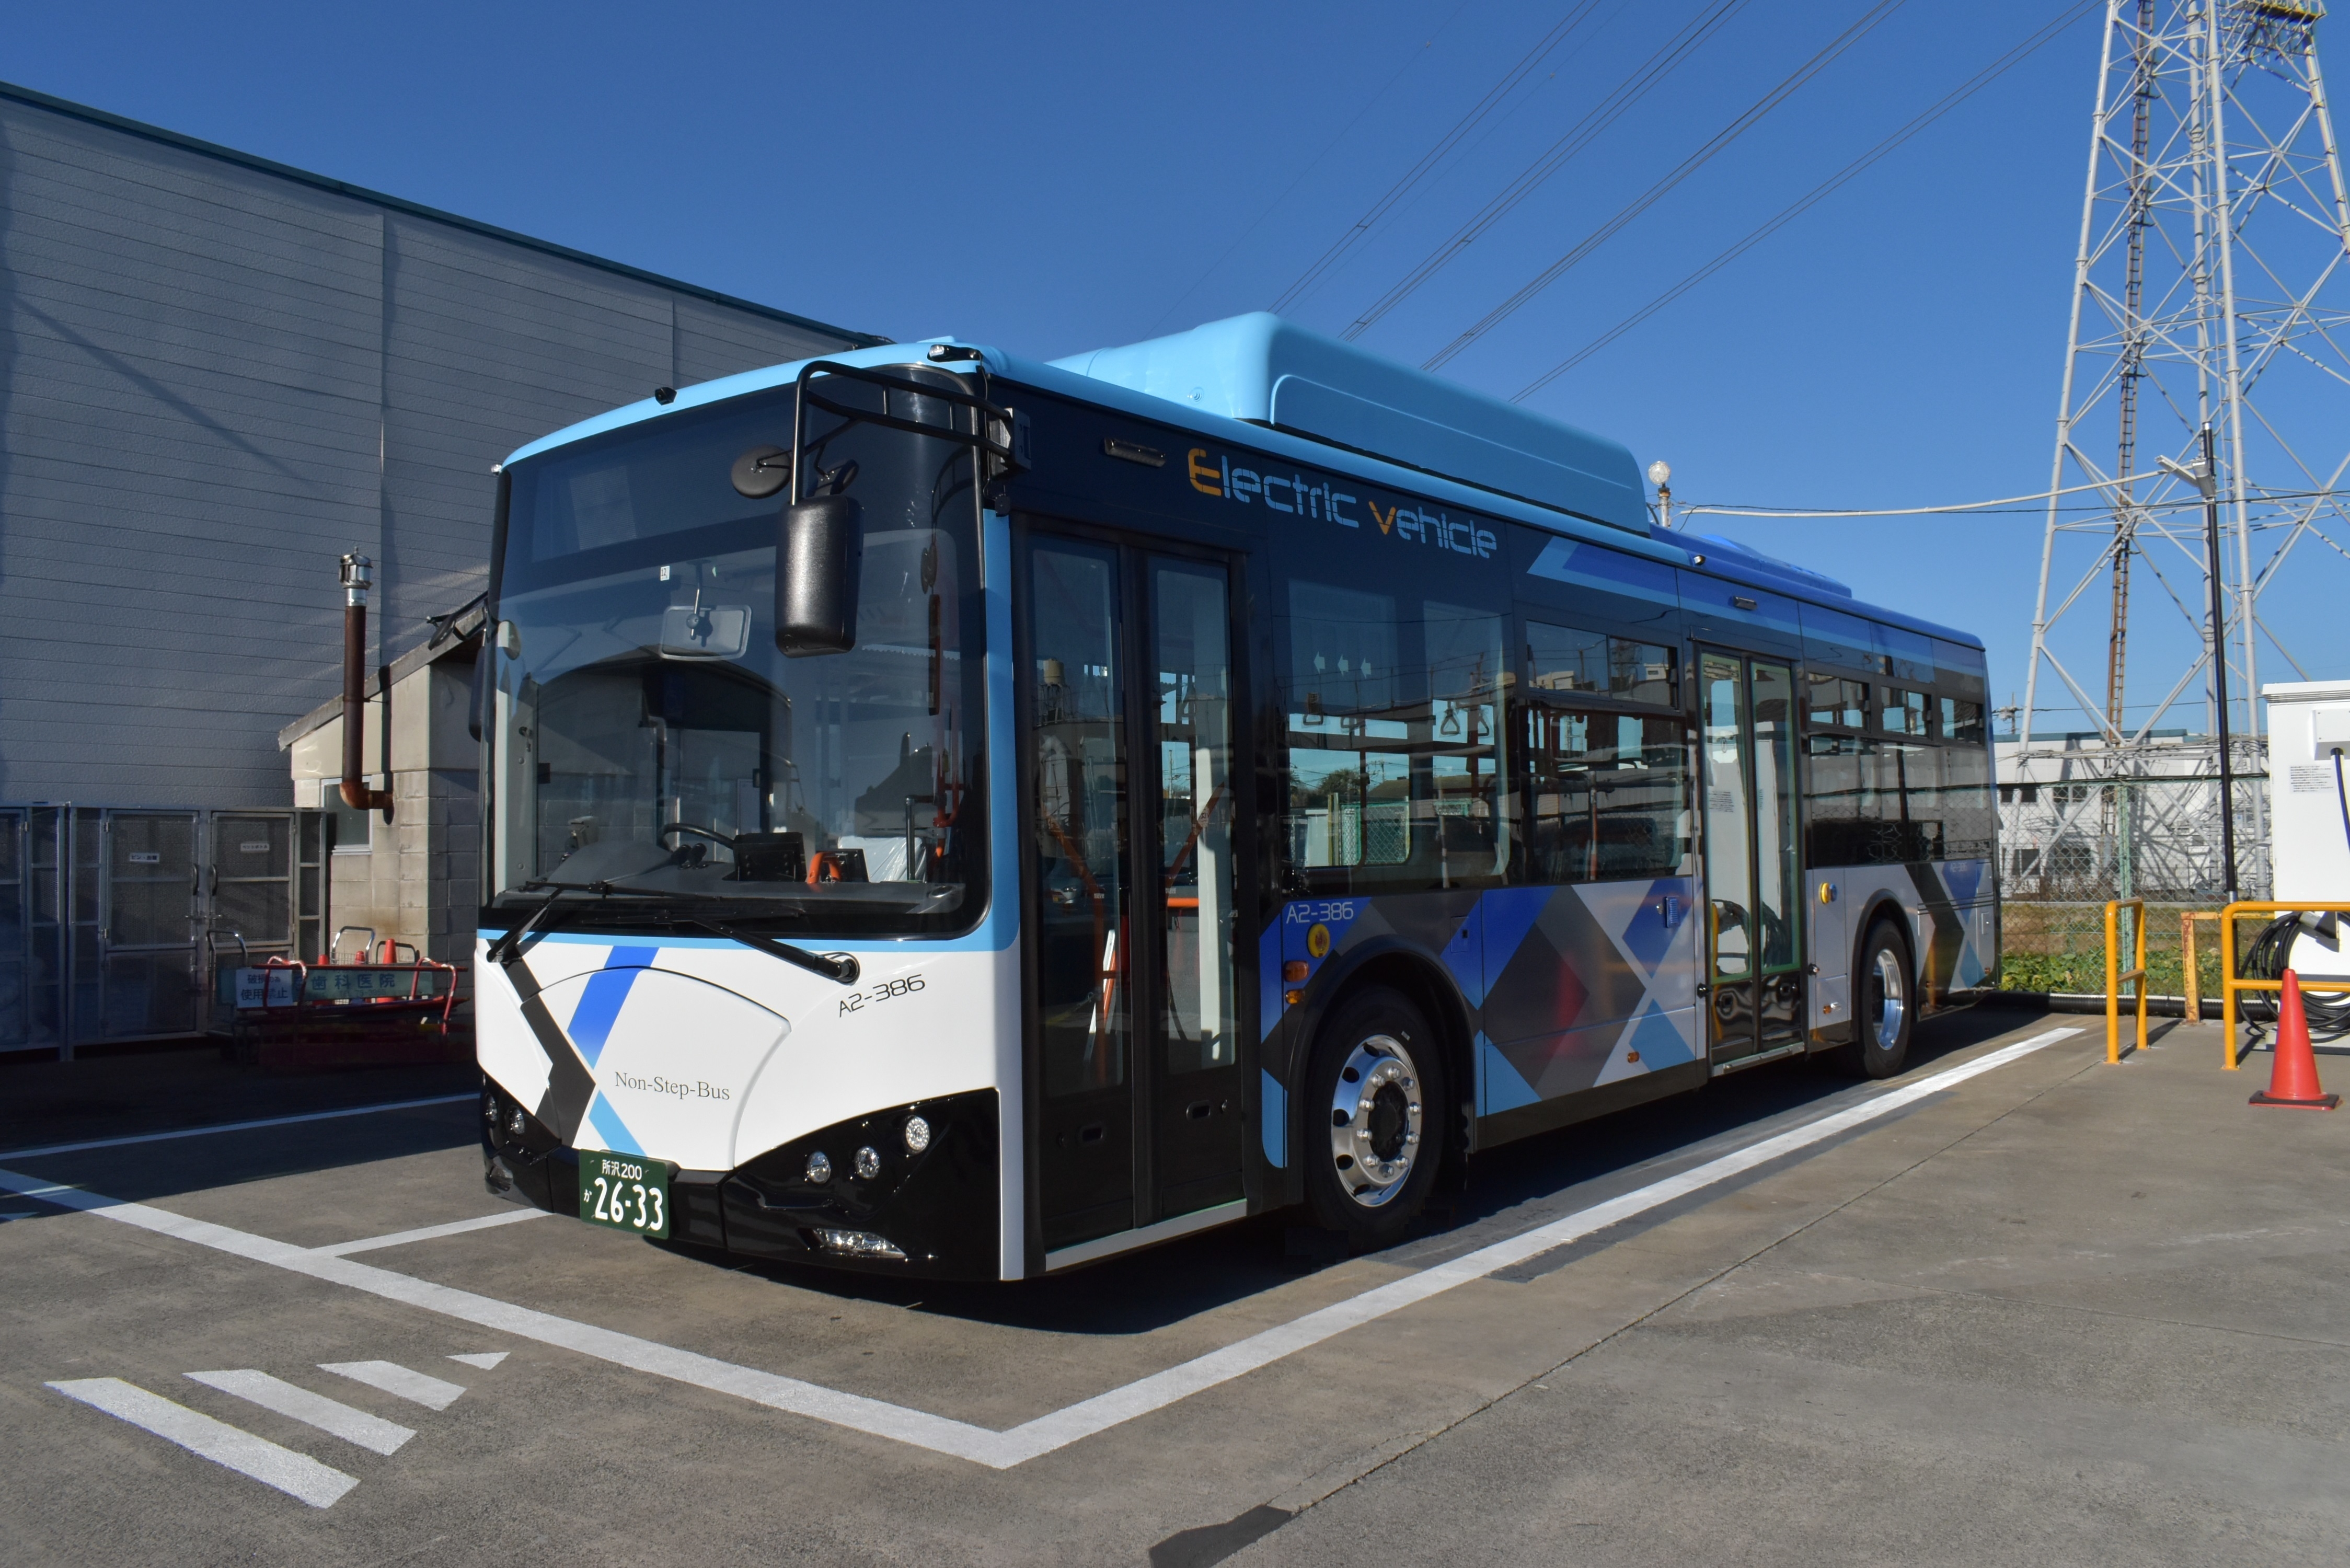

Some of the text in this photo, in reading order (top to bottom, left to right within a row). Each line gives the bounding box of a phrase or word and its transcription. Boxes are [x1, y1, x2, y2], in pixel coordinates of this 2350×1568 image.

[1188, 448, 1359, 528] Electric
[1286, 902, 1354, 924] A2-386
[241, 987, 289, 1000] 使用禁止
[839, 974, 925, 1018] A2-386
[615, 1071, 730, 1100] Non-Step-Bus
[583, 1177, 663, 1231] か 26-33
